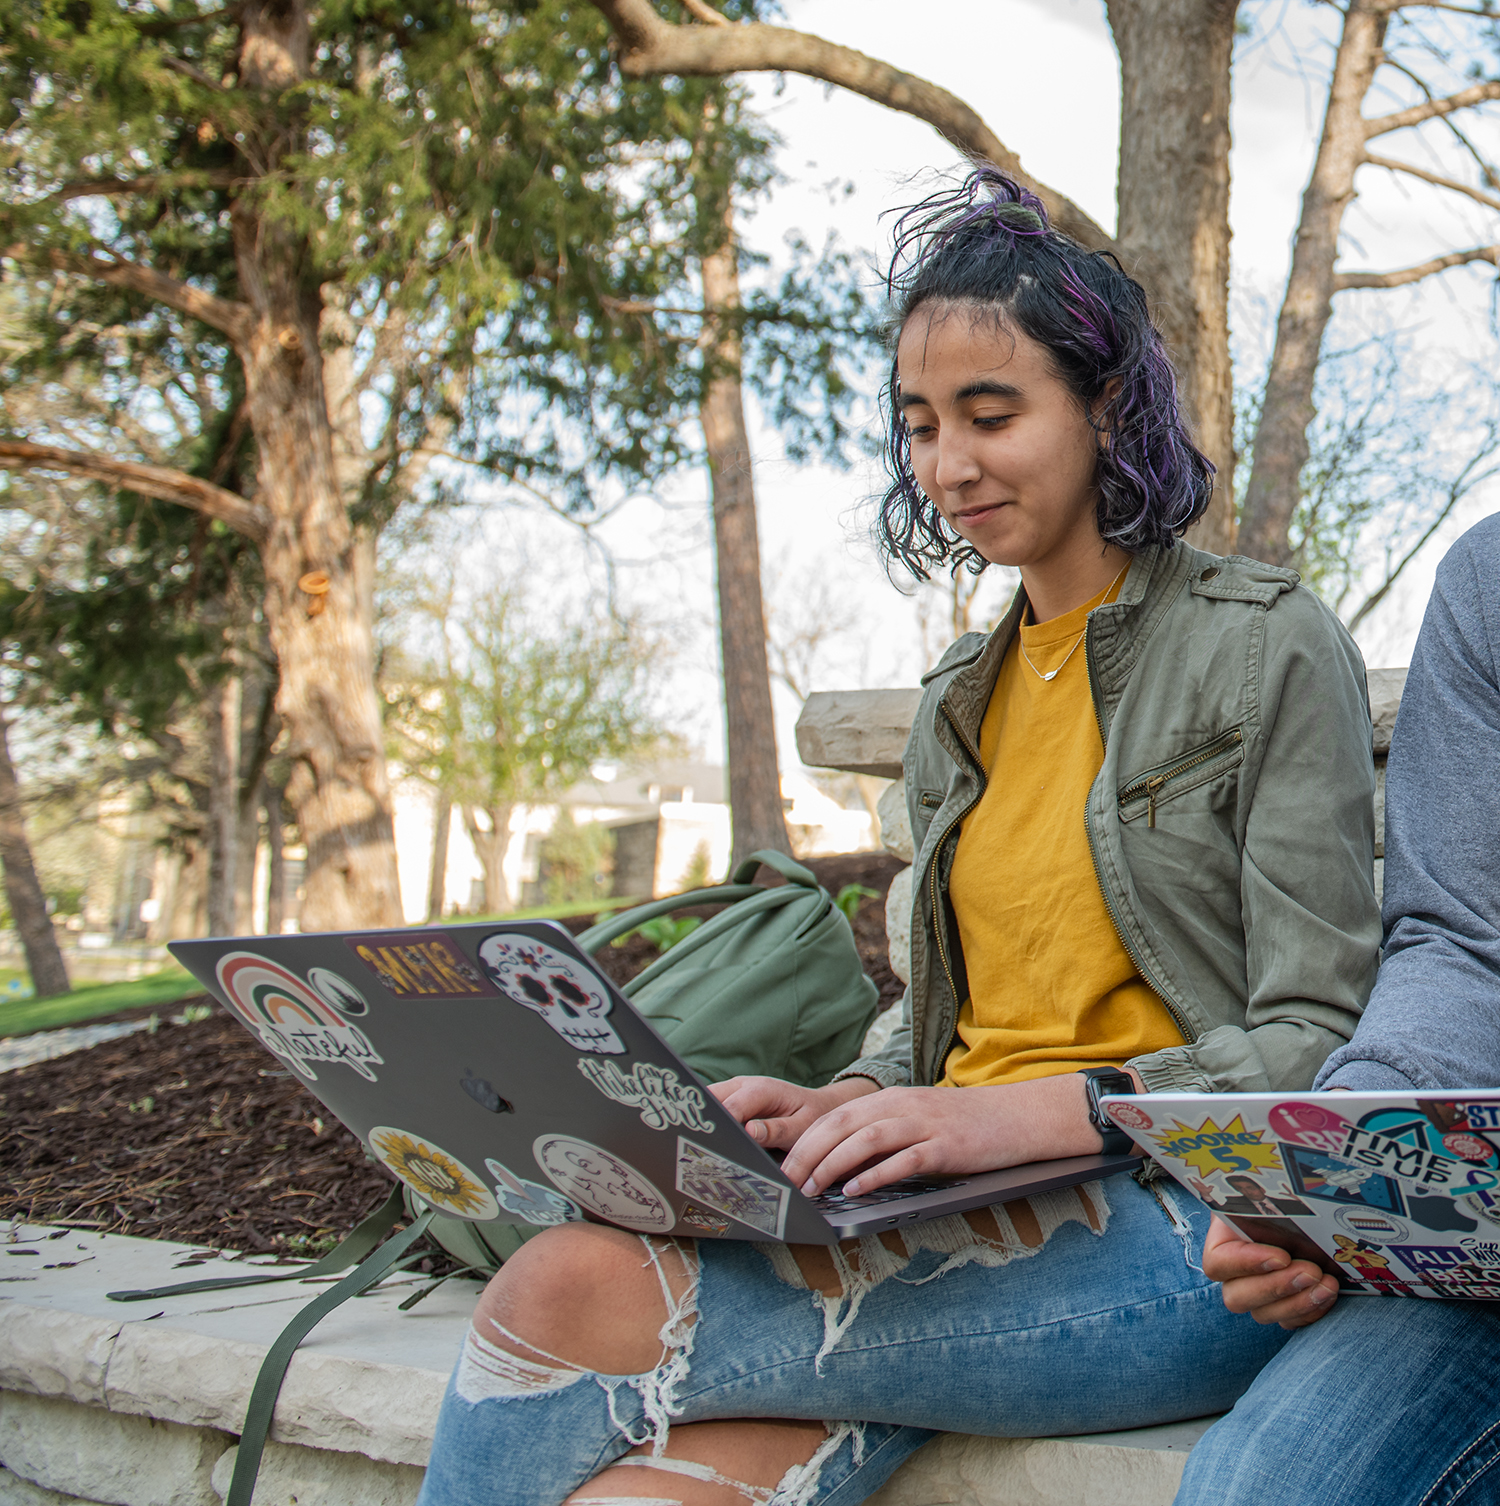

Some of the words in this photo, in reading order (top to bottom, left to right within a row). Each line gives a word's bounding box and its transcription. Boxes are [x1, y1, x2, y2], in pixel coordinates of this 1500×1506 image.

[1209, 1146, 1252, 1171] 5
[1342, 1123, 1457, 1175] TIME
[1343, 1144, 1384, 1167] IS
[1393, 1160, 1449, 1184] UP
[1411, 1250, 1472, 1265] ALL
